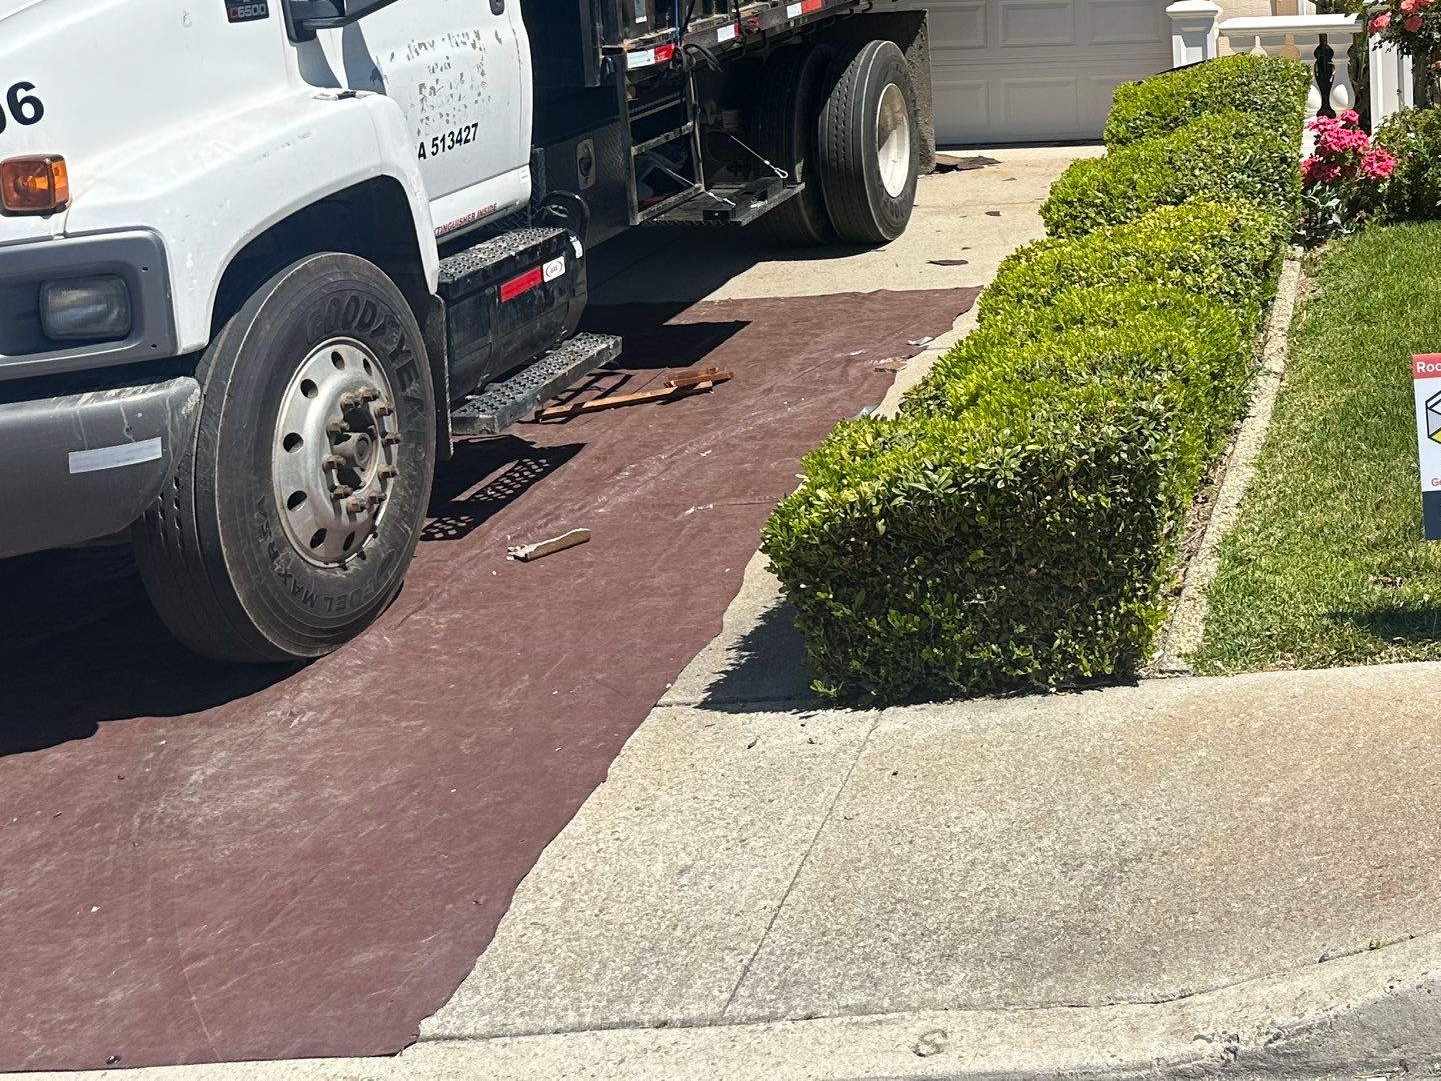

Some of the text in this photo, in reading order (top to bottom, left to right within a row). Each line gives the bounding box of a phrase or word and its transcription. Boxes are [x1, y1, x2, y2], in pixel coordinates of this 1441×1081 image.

[229, 3, 267, 19] C6500
[0, 81, 44, 135] 6
[431, 122, 479, 157] 513427
[477, 203, 498, 219] INSIDE
